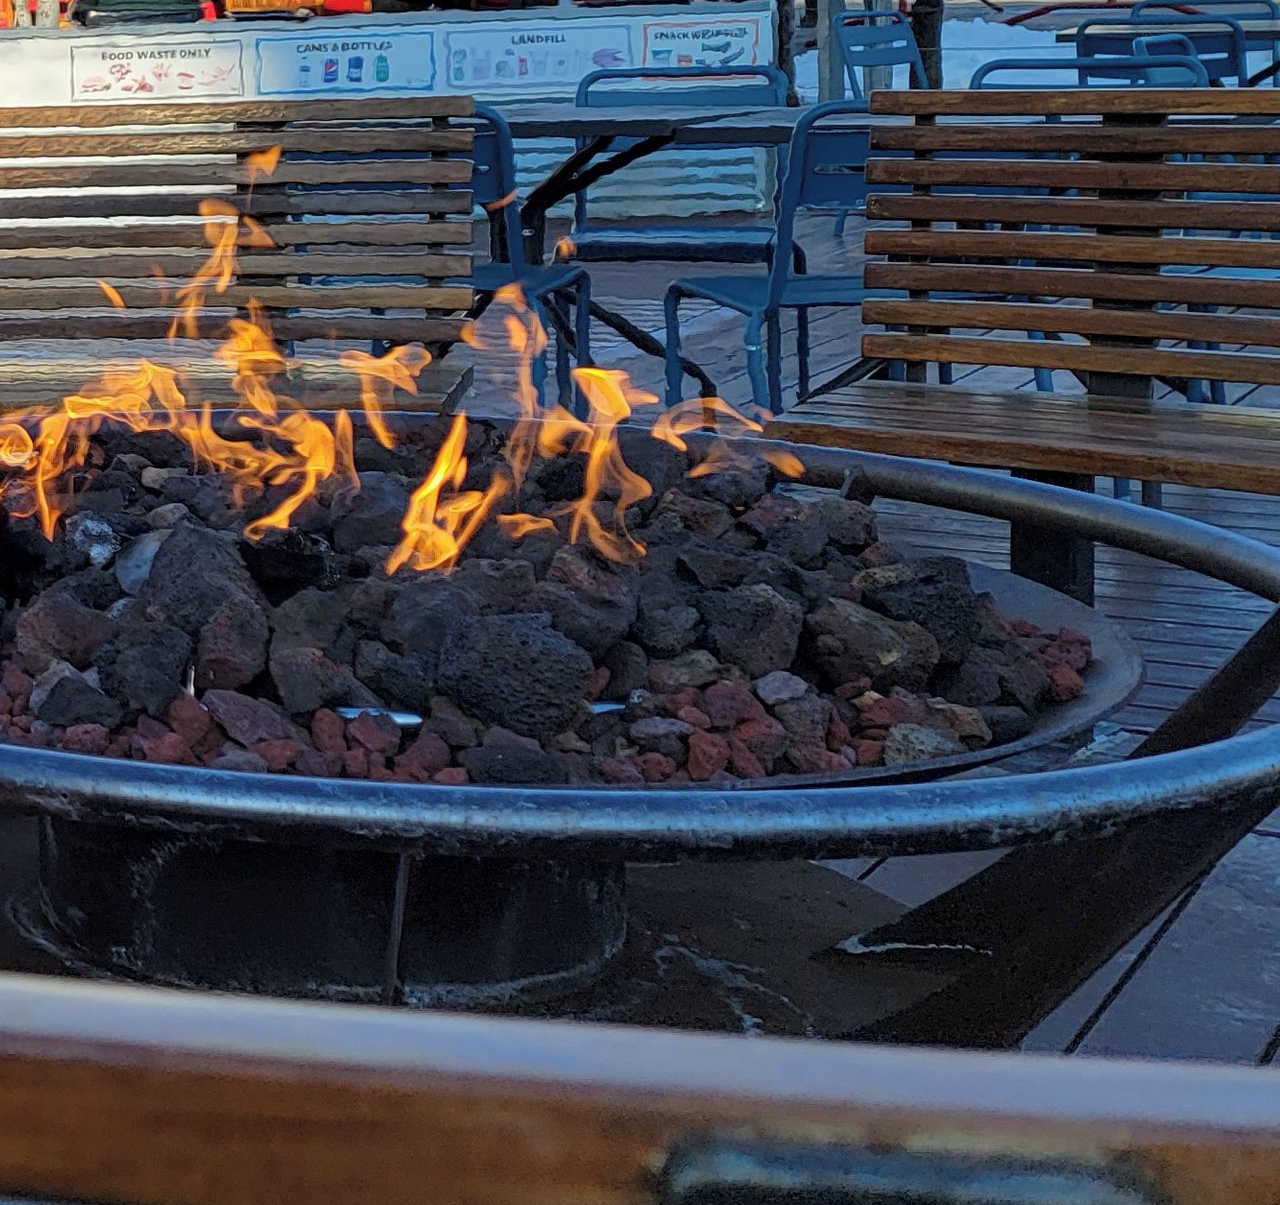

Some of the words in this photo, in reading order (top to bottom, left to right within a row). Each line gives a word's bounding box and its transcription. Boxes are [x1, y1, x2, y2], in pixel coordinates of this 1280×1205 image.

[511, 33, 567, 45] LANDFILL
[653, 30, 691, 41] SNACK
[101, 50, 134, 61] FOOD
[136, 49, 178, 60] WASTE
[179, 47, 212, 60] ONLY
[296, 43, 329, 55] CANS
